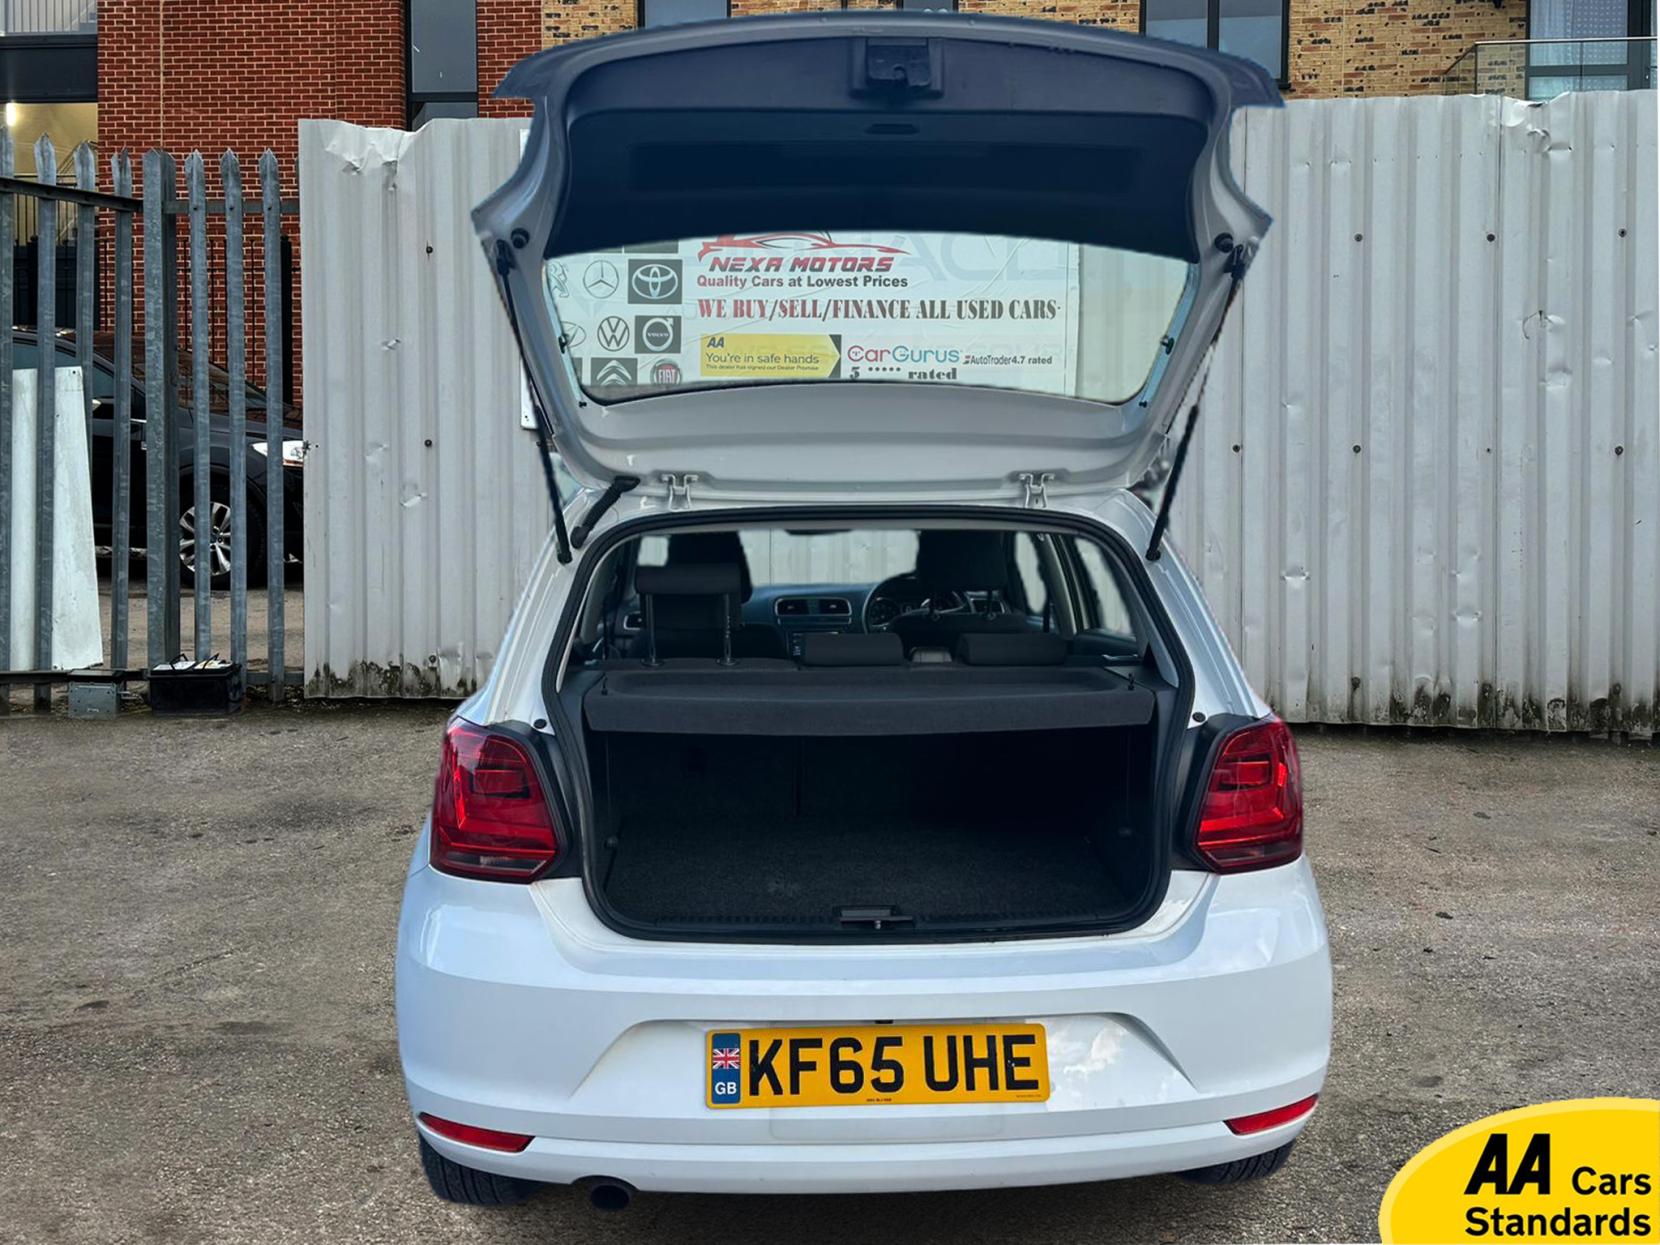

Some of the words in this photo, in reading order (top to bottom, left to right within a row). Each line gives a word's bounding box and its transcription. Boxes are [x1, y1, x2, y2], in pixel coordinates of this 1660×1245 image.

[709, 257, 784, 272] NEXA
[789, 257, 894, 272] MOTORS
[697, 275, 747, 289] Quality
[752, 276, 784, 287] Cars
[788, 276, 802, 287] at
[807, 275, 858, 287] Lowest
[863, 275, 908, 287] Prices
[698, 299, 726, 318] WE
[733, 299, 911, 322] BUY/SELL/FINANCE
[916, 299, 951, 319] ALL
[956, 299, 1004, 319] USED
[707, 336, 725, 348] AA
[706, 353, 741, 363] You're
[744, 353, 753, 363] in
[757, 353, 781, 363] safe
[784, 353, 819, 364] hands
[847, 345, 960, 363] CarGurus
[1028, 356, 1053, 365] rated
[658, 370, 676, 382] FIAT
[908, 368, 957, 380] rated
[748, 1036, 905, 1096] KF65
[923, 1034, 1040, 1092] UHE
[715, 1082, 737, 1095] GB
